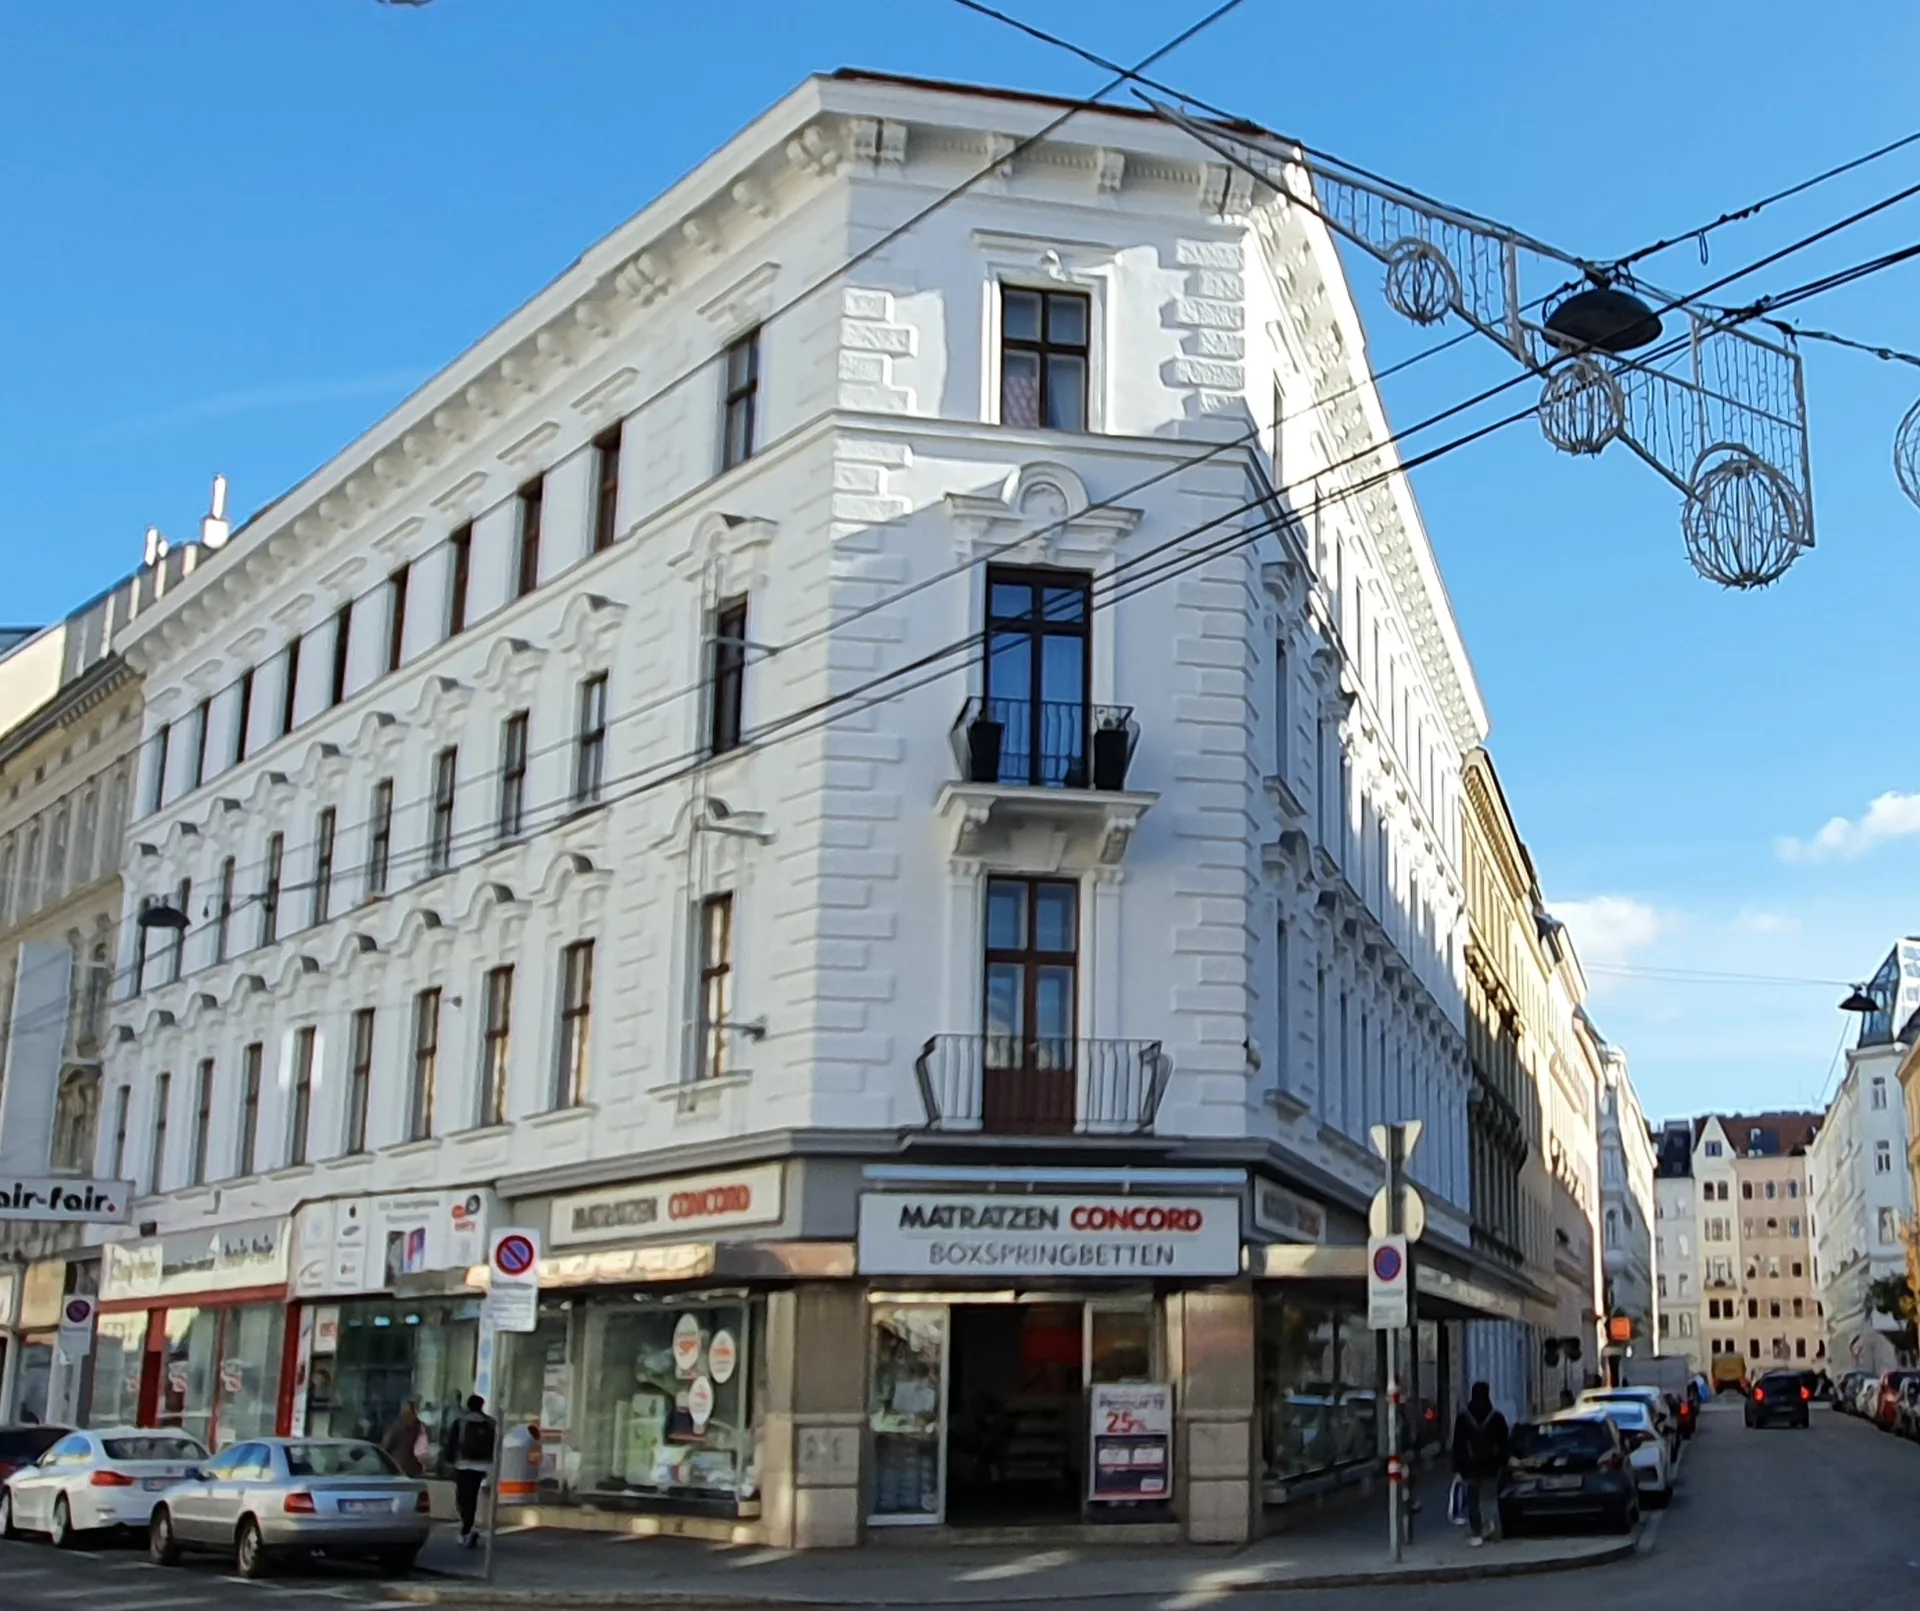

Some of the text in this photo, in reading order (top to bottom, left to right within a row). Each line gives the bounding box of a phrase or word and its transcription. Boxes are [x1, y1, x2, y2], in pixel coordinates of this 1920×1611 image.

[899, 1204, 1204, 1232] MATRATZEN CONCORD
[929, 1242, 1175, 1267] BOXSPRINGBETTEN
